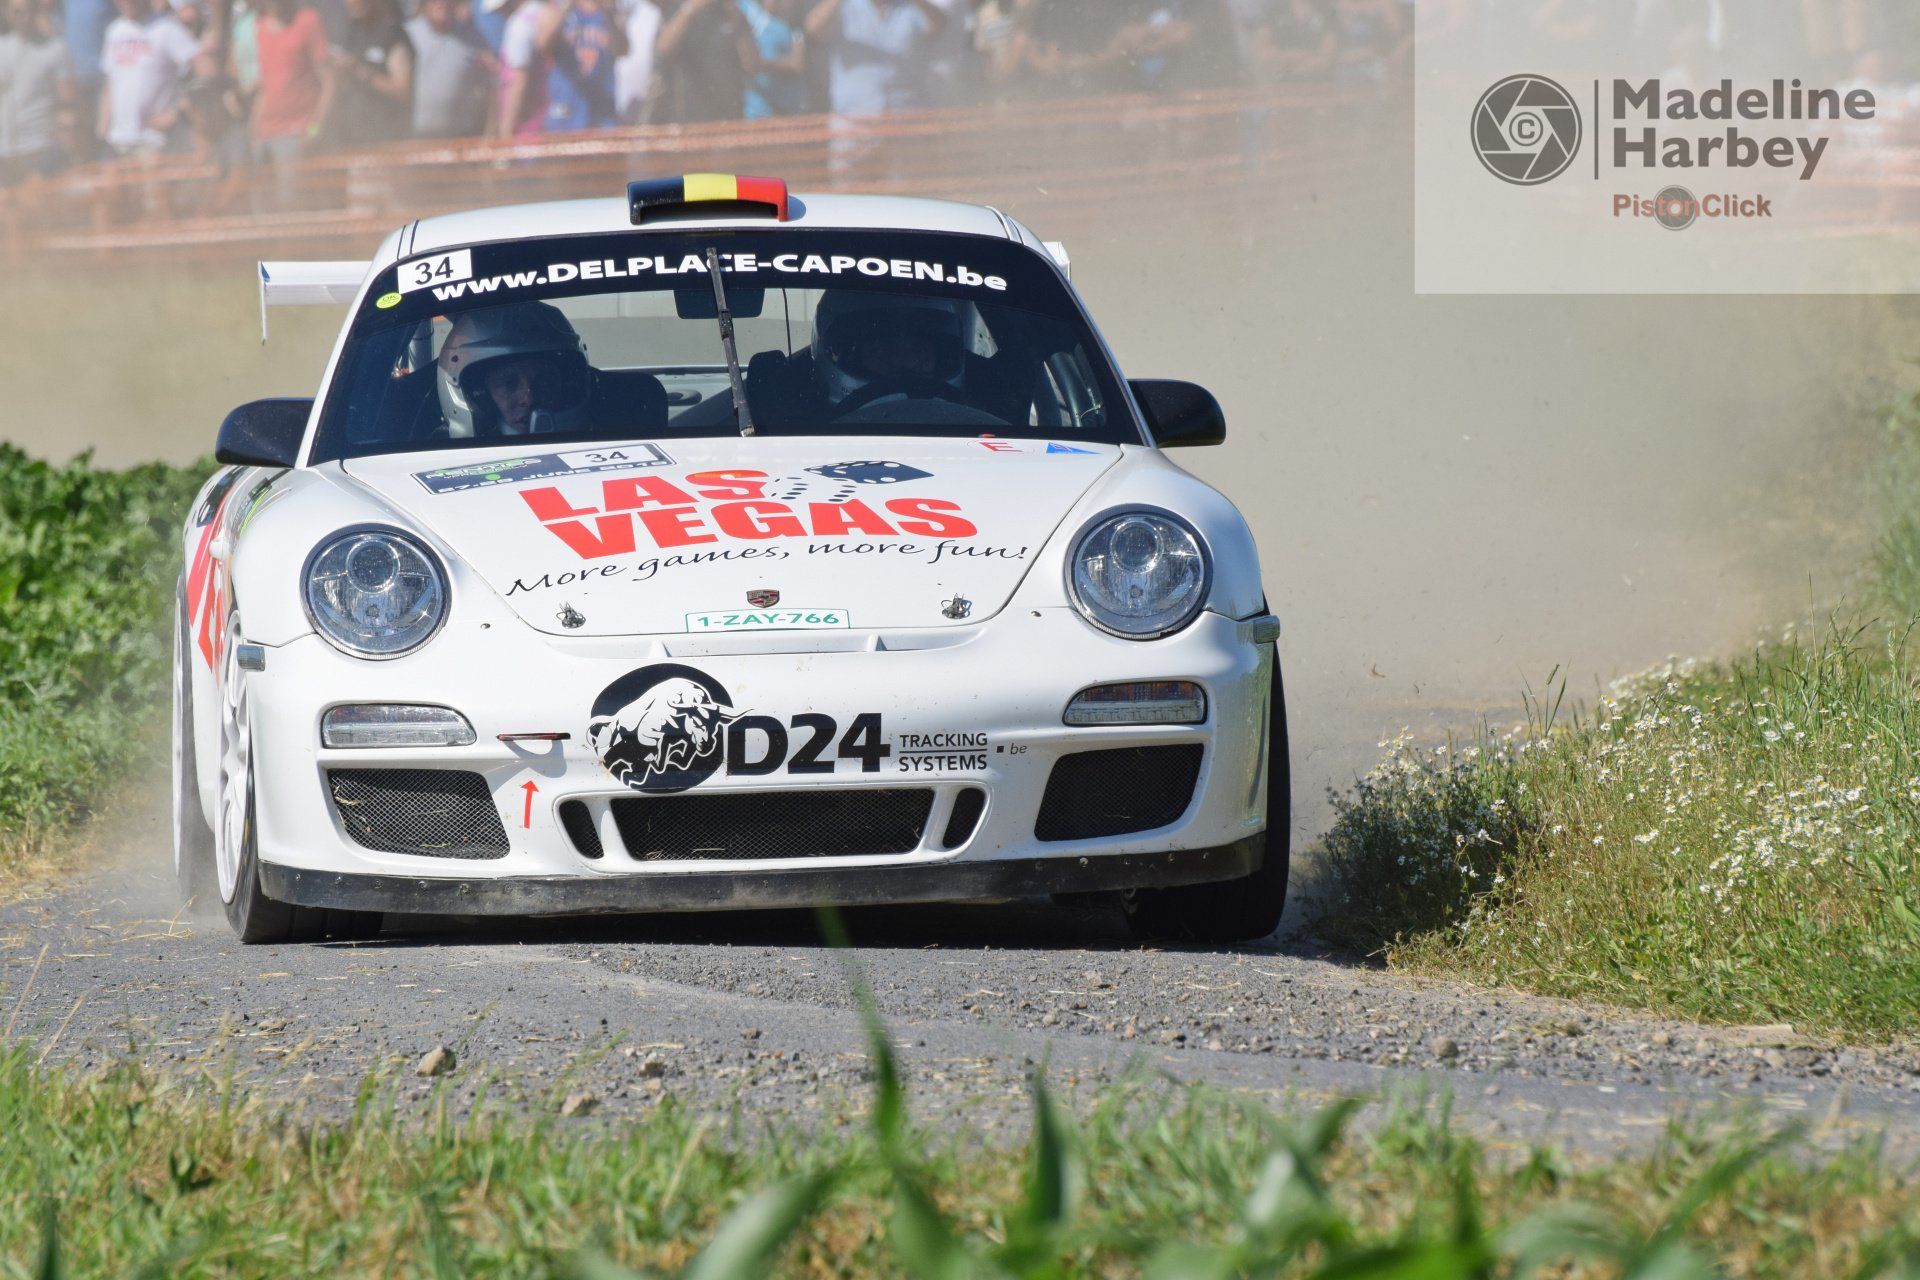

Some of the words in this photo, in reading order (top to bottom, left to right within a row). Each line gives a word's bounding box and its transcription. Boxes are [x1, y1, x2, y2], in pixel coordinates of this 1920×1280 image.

[414, 257, 454, 285] 34
[585, 451, 629, 463] 34
[518, 470, 770, 522] LAS
[543, 498, 978, 560] VEGAS
[505, 564, 627, 596] More
[632, 546, 790, 582] games,
[808, 542, 925, 555] more
[927, 540, 1028, 564] fun!
[697, 613, 839, 627] 1-ZAY-766
[727, 712, 891, 777] D24
[899, 733, 988, 748] TRACKING
[899, 754, 987, 772] SYSTEMS
